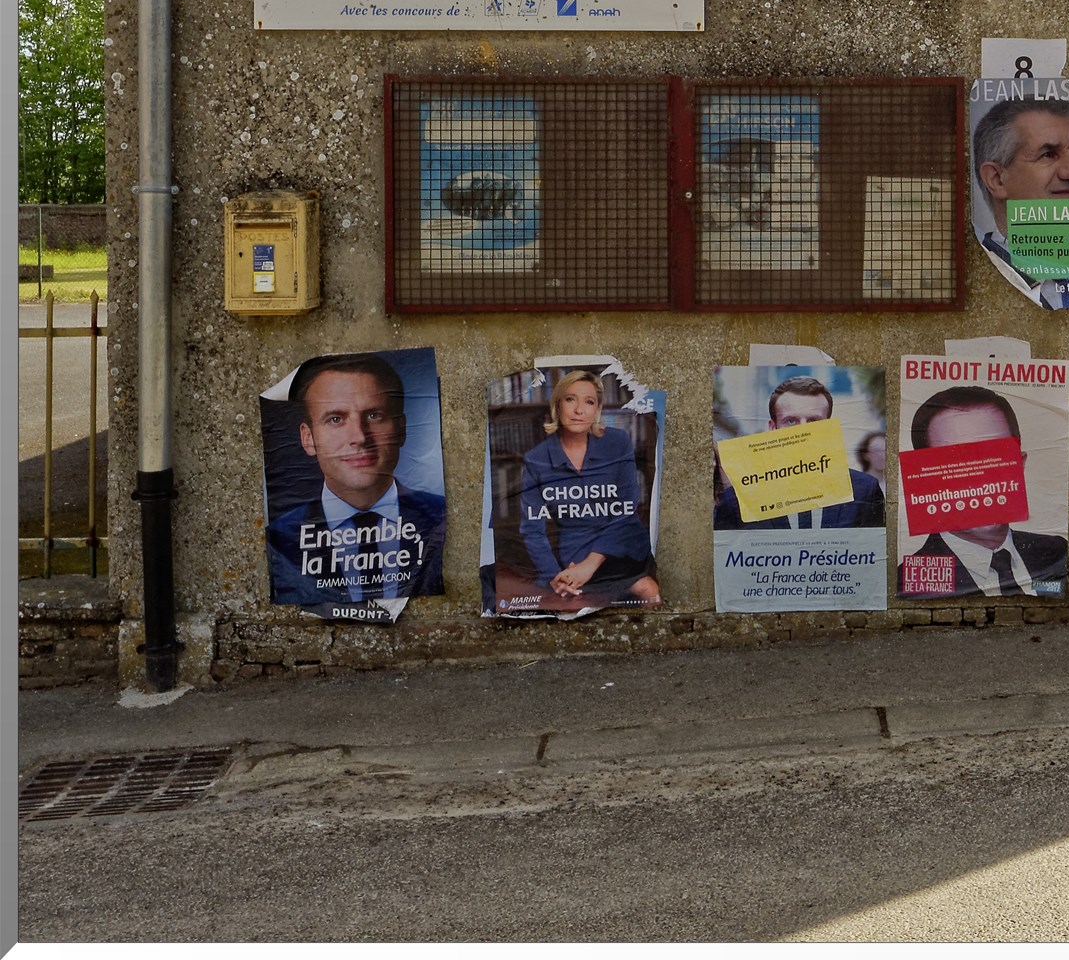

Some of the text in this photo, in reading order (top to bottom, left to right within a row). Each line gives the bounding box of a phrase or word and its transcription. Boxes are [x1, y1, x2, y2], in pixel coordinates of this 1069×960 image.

[340, 5, 443, 16] Avec concours
[1014, 55, 1034, 78] 8
[970, 80, 1025, 102] JEAN
[1011, 206, 1047, 222] JEAN
[1011, 233, 1064, 244] Retrouvez
[1013, 246, 1054, 257] réunions
[905, 360, 1066, 384] BENOIT HAMON
[741, 454, 831, 486] en-marche.fr
[542, 484, 618, 501] CHOISIR
[911, 480, 1019, 505] benoithamon2017.fr
[528, 501, 635, 521] LA FRANCE
[300, 516, 421, 549] Ensemble,
[301, 548, 411, 575] la France
[725, 549, 876, 567] Macron Président
[905, 557, 953, 567] FAIRE BATTRE
[316, 572, 411, 588] EMMANUEL MACRON
[772, 570, 851, 583] France doit être
[905, 568, 953, 582] LE CŒUR
[743, 585, 830, 598] une chance pour
[926, 583, 953, 592] FRANCE
[511, 596, 542, 604] MARINE
